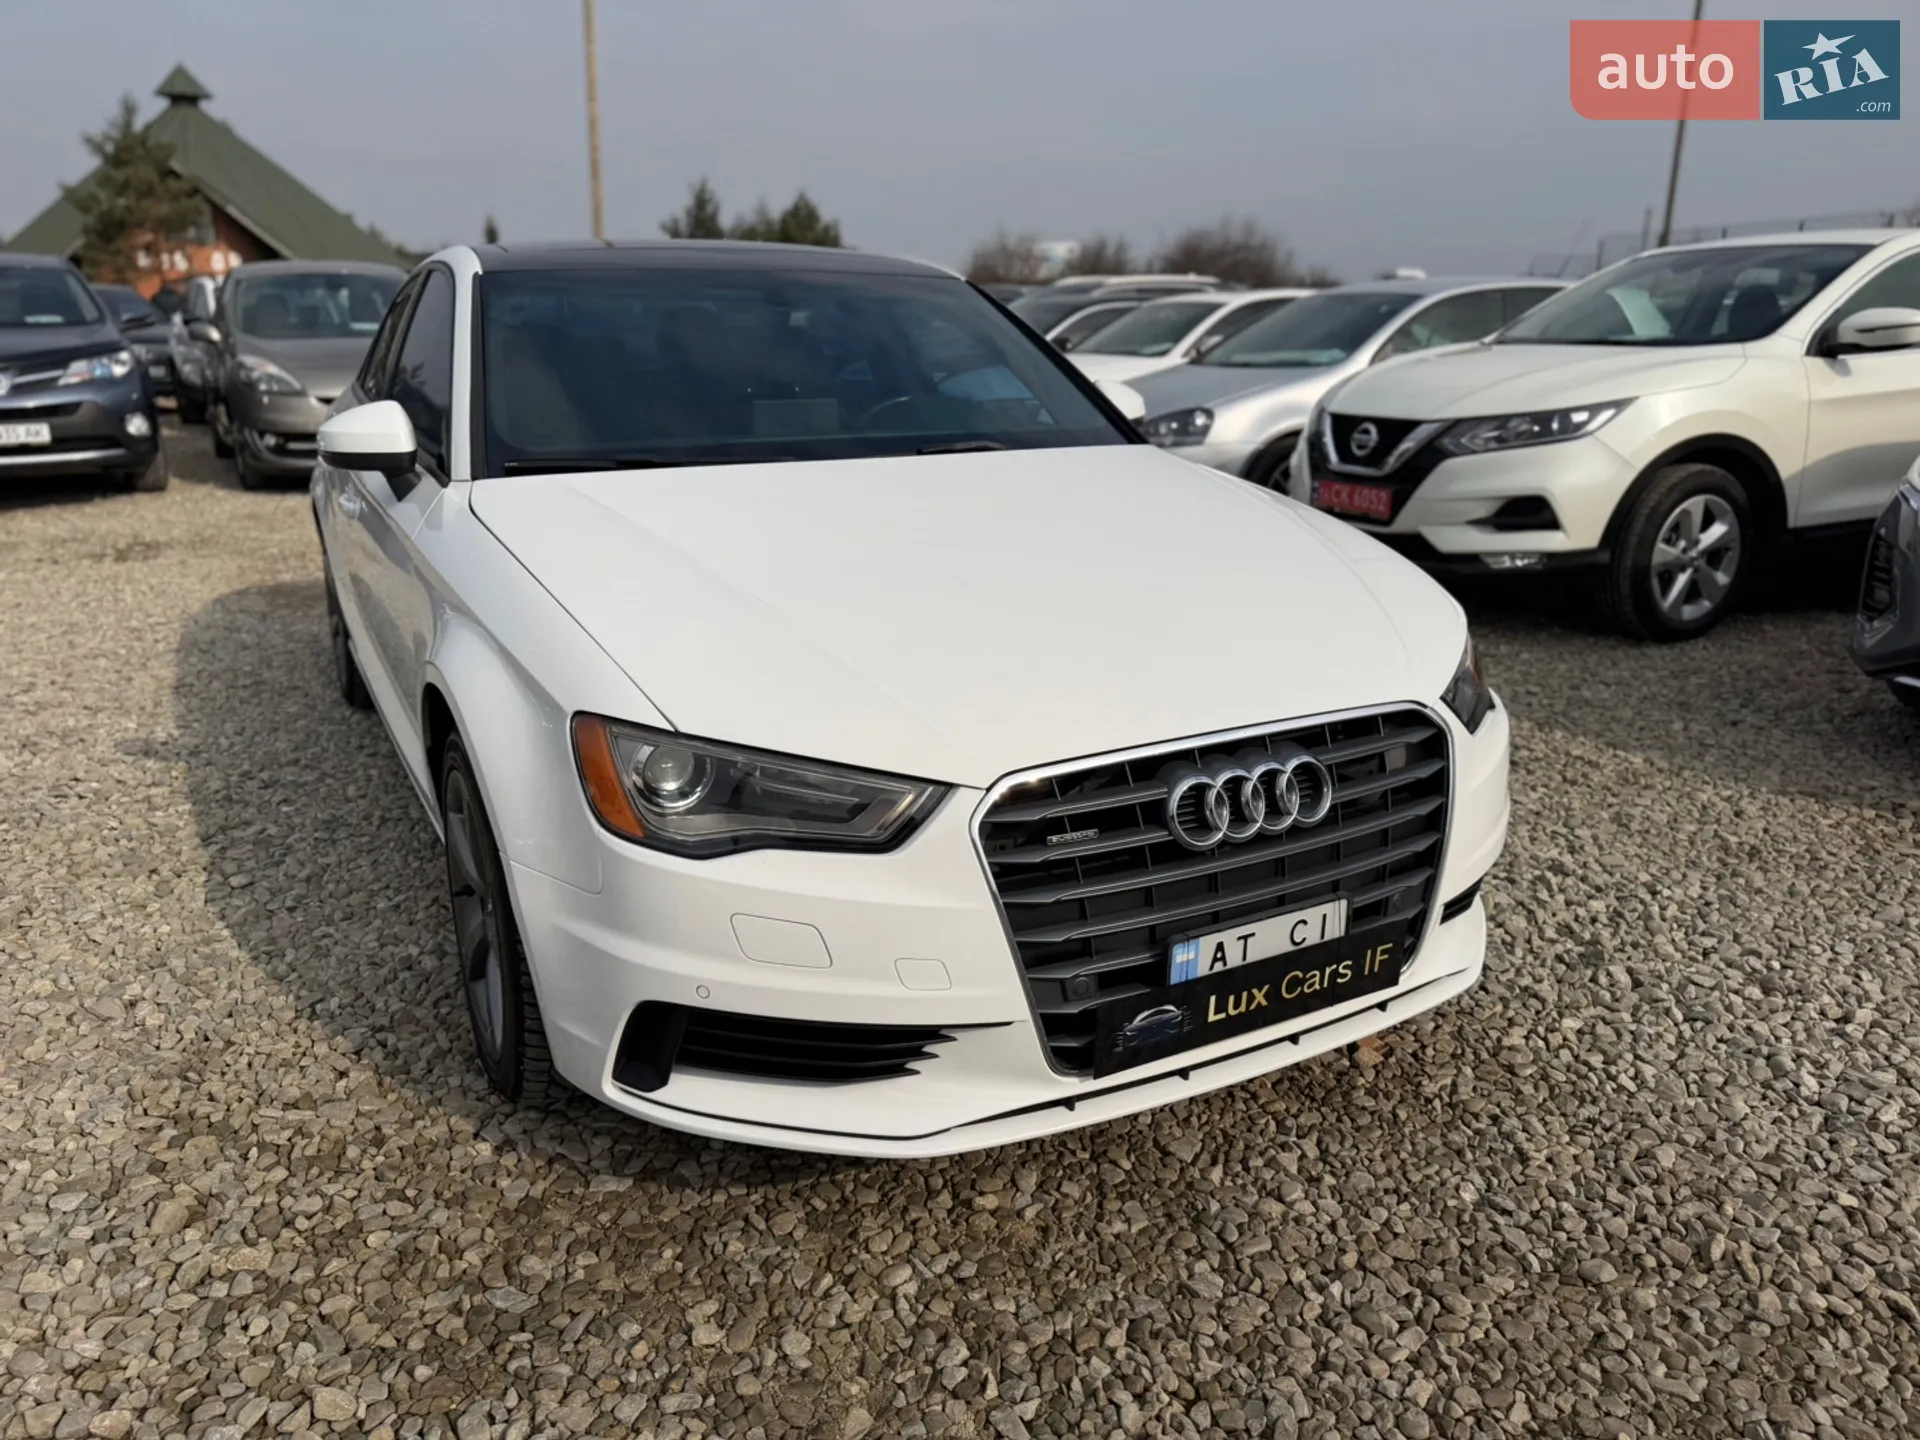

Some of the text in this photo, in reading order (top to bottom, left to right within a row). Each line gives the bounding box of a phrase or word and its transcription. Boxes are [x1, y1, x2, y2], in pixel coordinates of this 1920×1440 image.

[1208, 932, 1256, 971] AT
[1207, 942, 1393, 1023] Lux Cars IF
